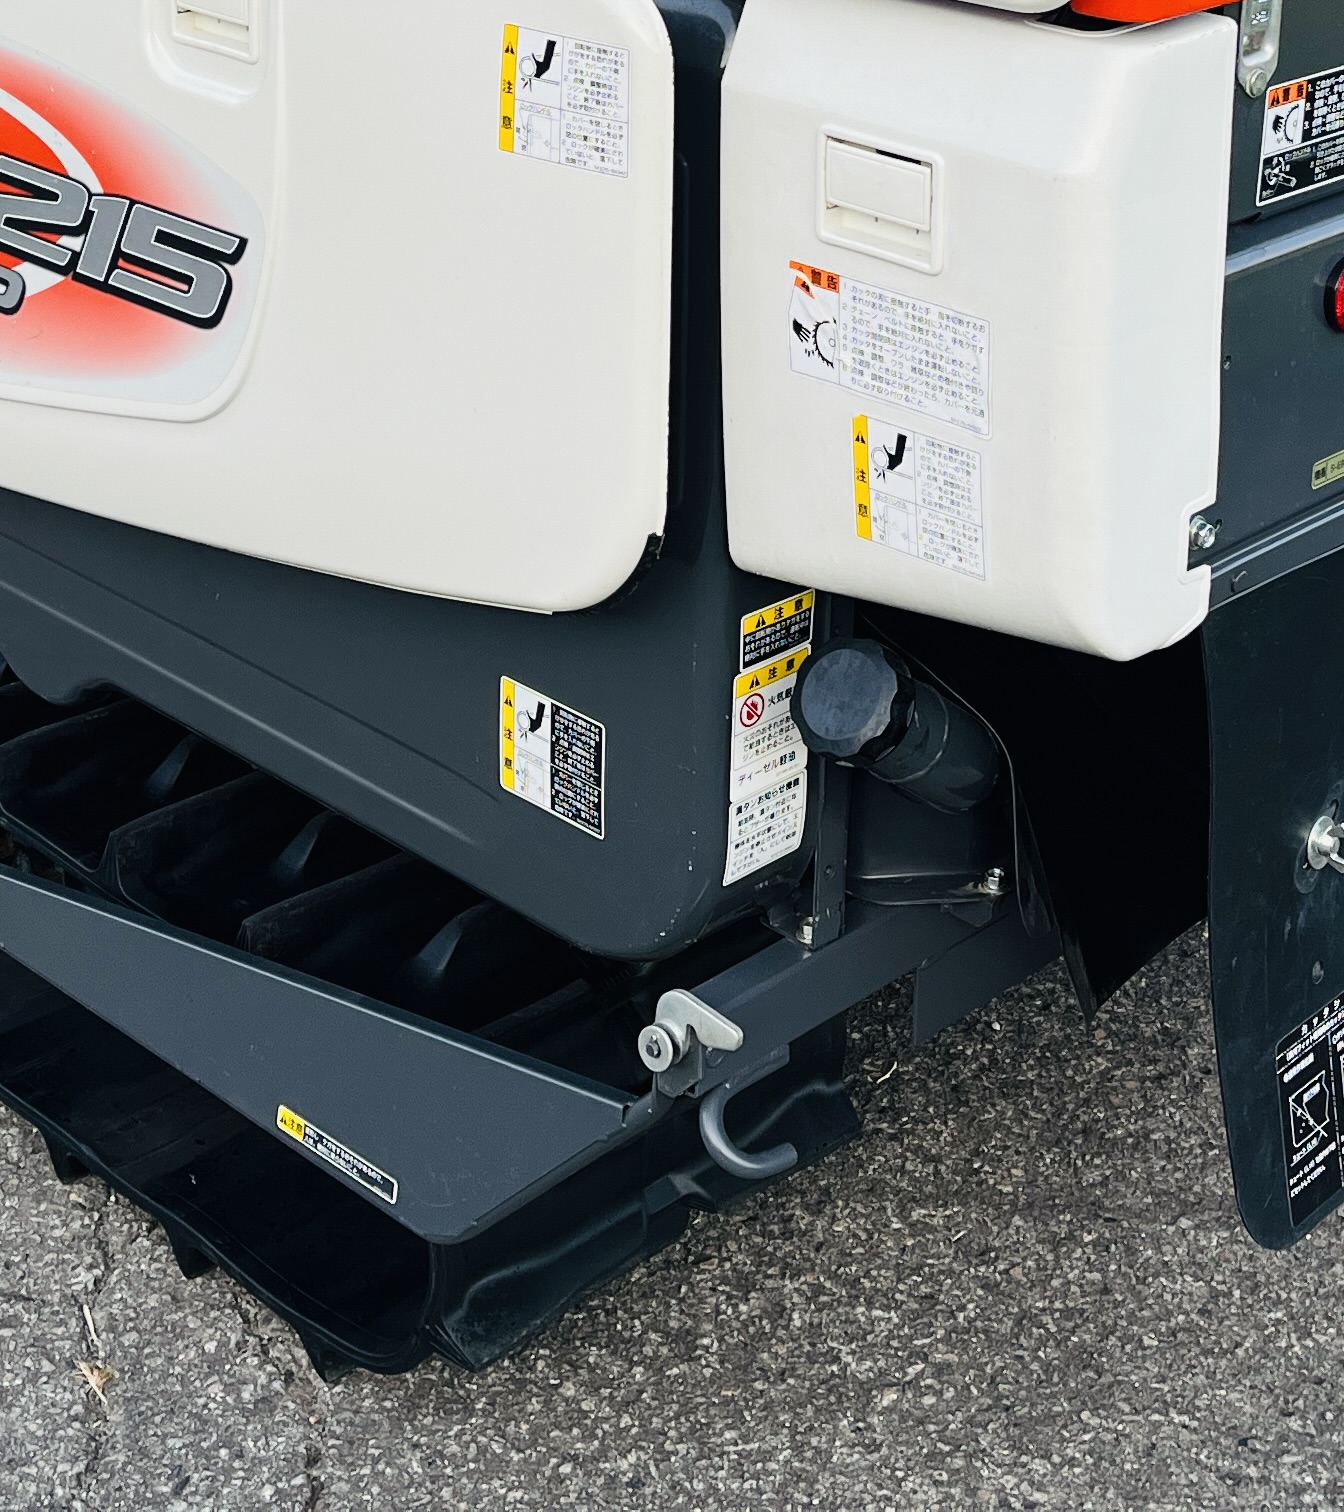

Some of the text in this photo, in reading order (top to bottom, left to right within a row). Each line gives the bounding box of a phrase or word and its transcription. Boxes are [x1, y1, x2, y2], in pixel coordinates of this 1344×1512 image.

[501, 78, 514, 131] 注意
[811, 268, 840, 291] 警告
[855, 467, 869, 519] 注意
[773, 596, 804, 621] 注意
[767, 656, 795, 681] 注意
[767, 685, 793, 708] 火気厳
[503, 725, 513, 771] 注意
[742, 721, 796, 753] で給油するときはエ
